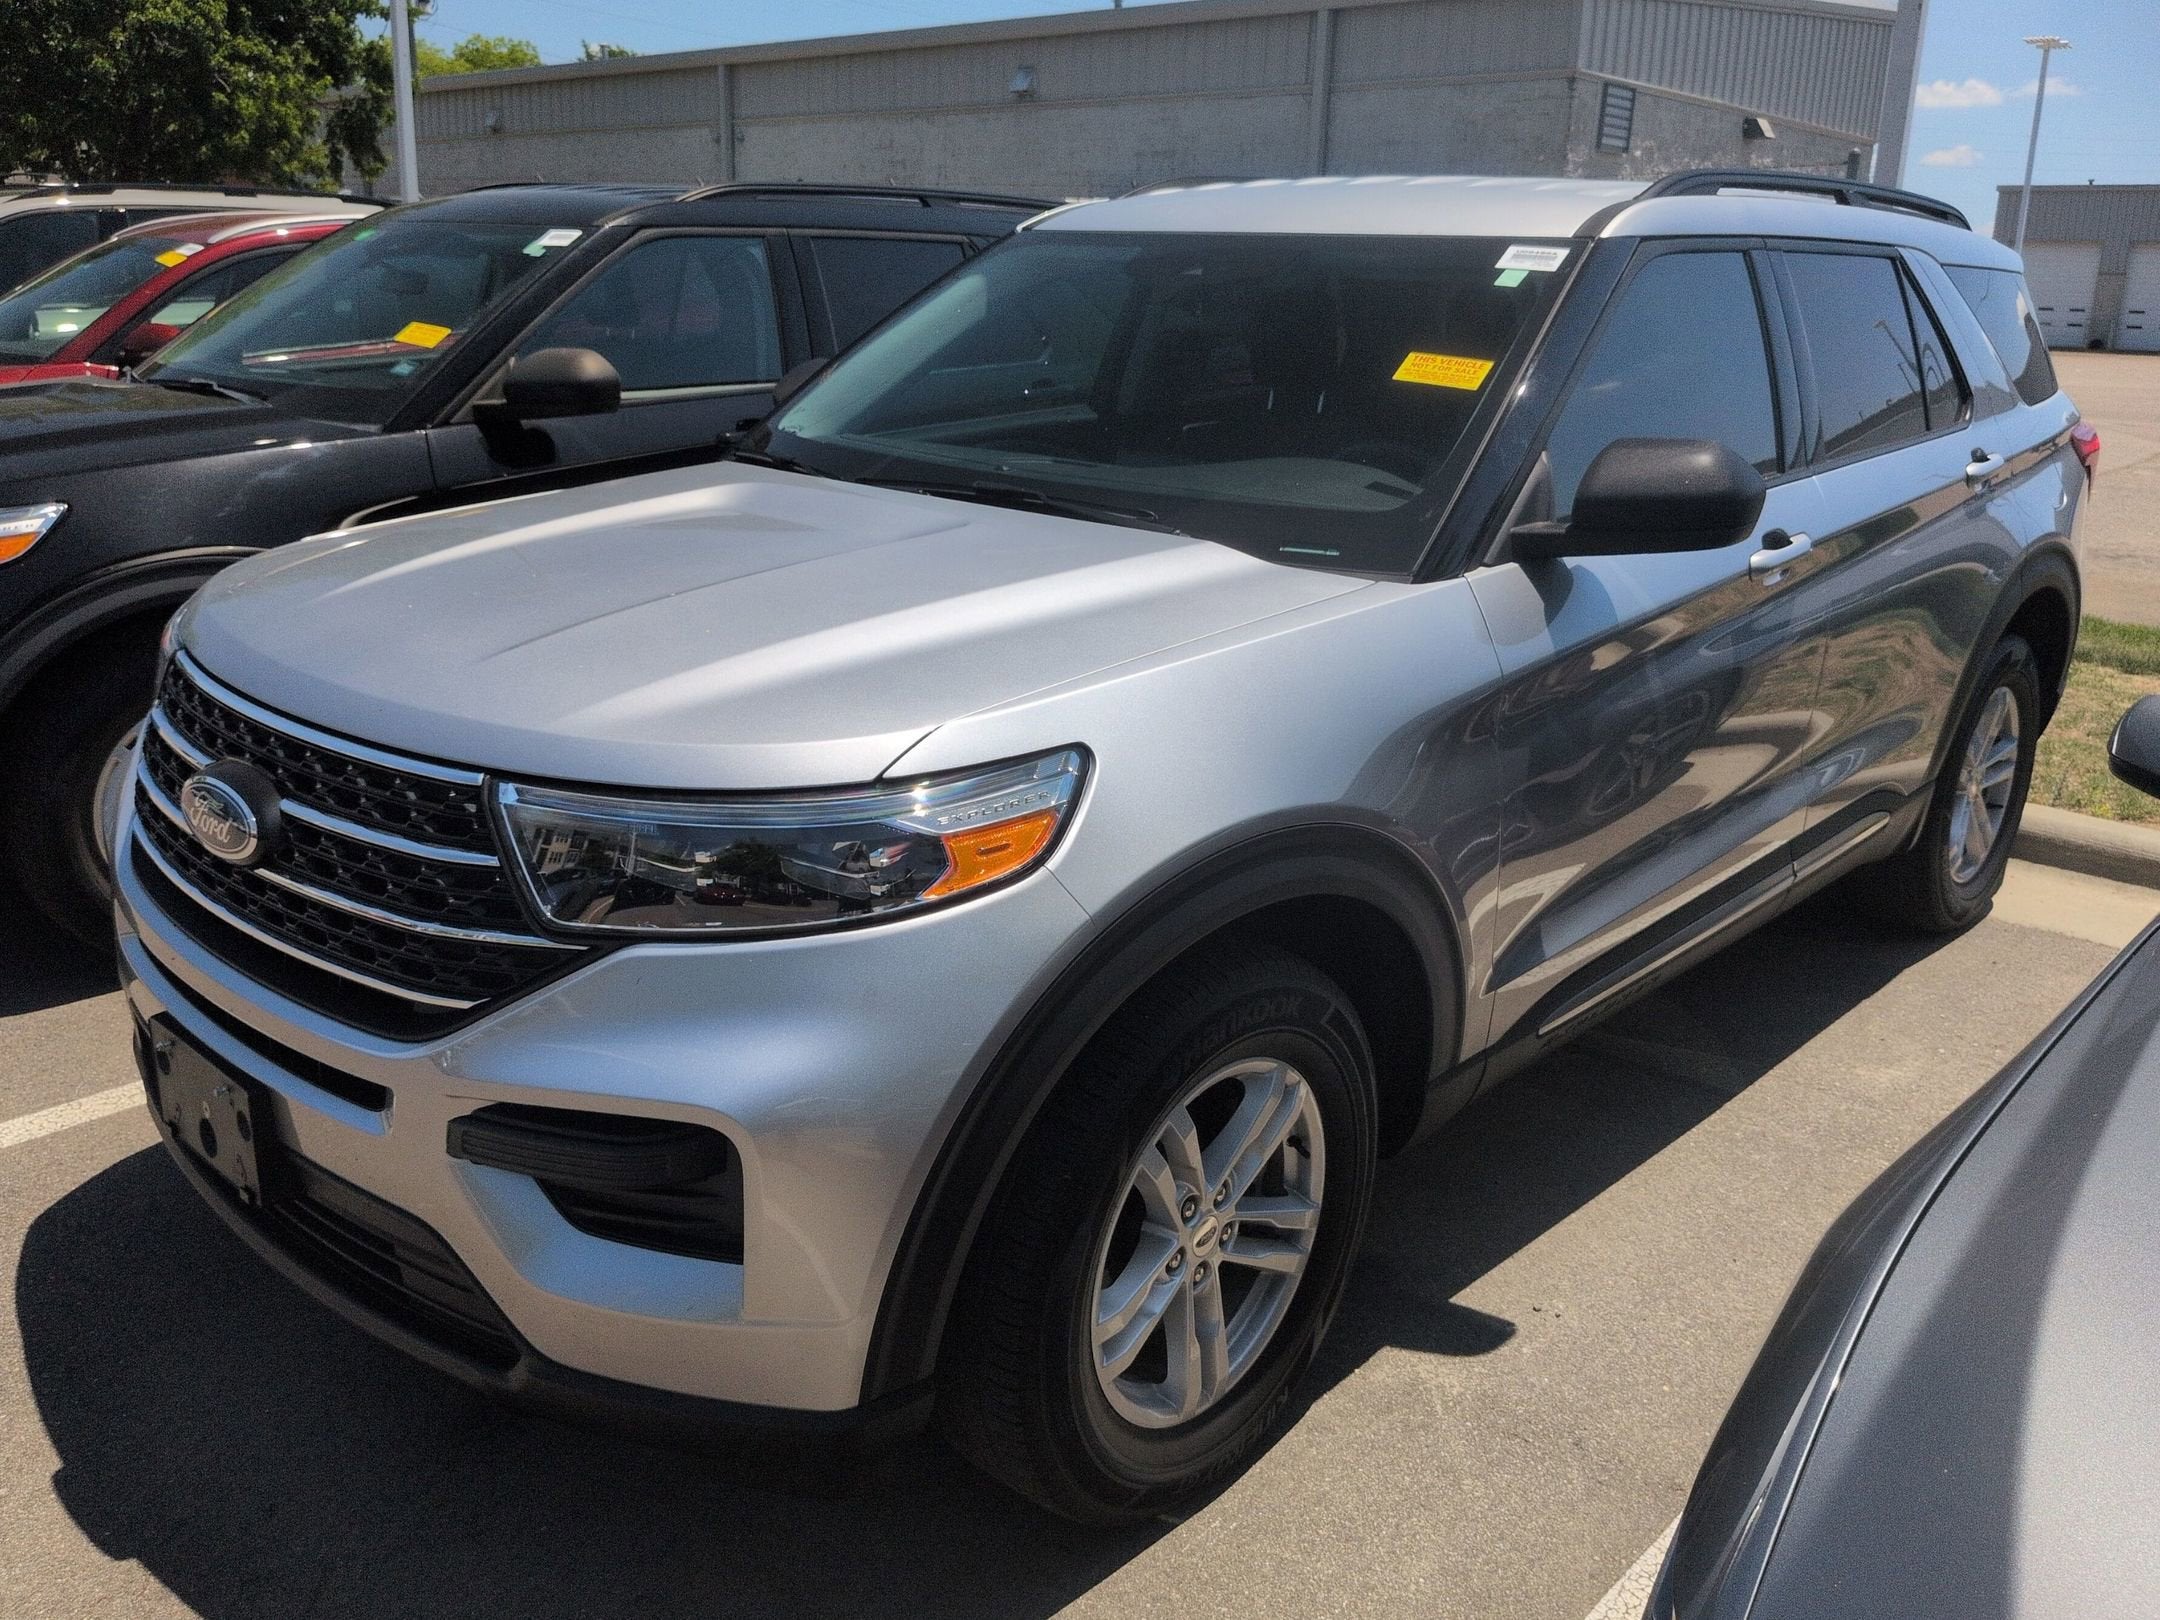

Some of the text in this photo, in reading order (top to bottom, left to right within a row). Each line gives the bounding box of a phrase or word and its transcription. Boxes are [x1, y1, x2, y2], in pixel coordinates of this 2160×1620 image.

[1413, 355, 1487, 370] THIS VEHICLE
[1431, 364, 1452, 372] FOR
[1454, 367, 1480, 375] SALE
[191, 790, 237, 843] Ford
[937, 792, 1052, 825] EXPLORER
